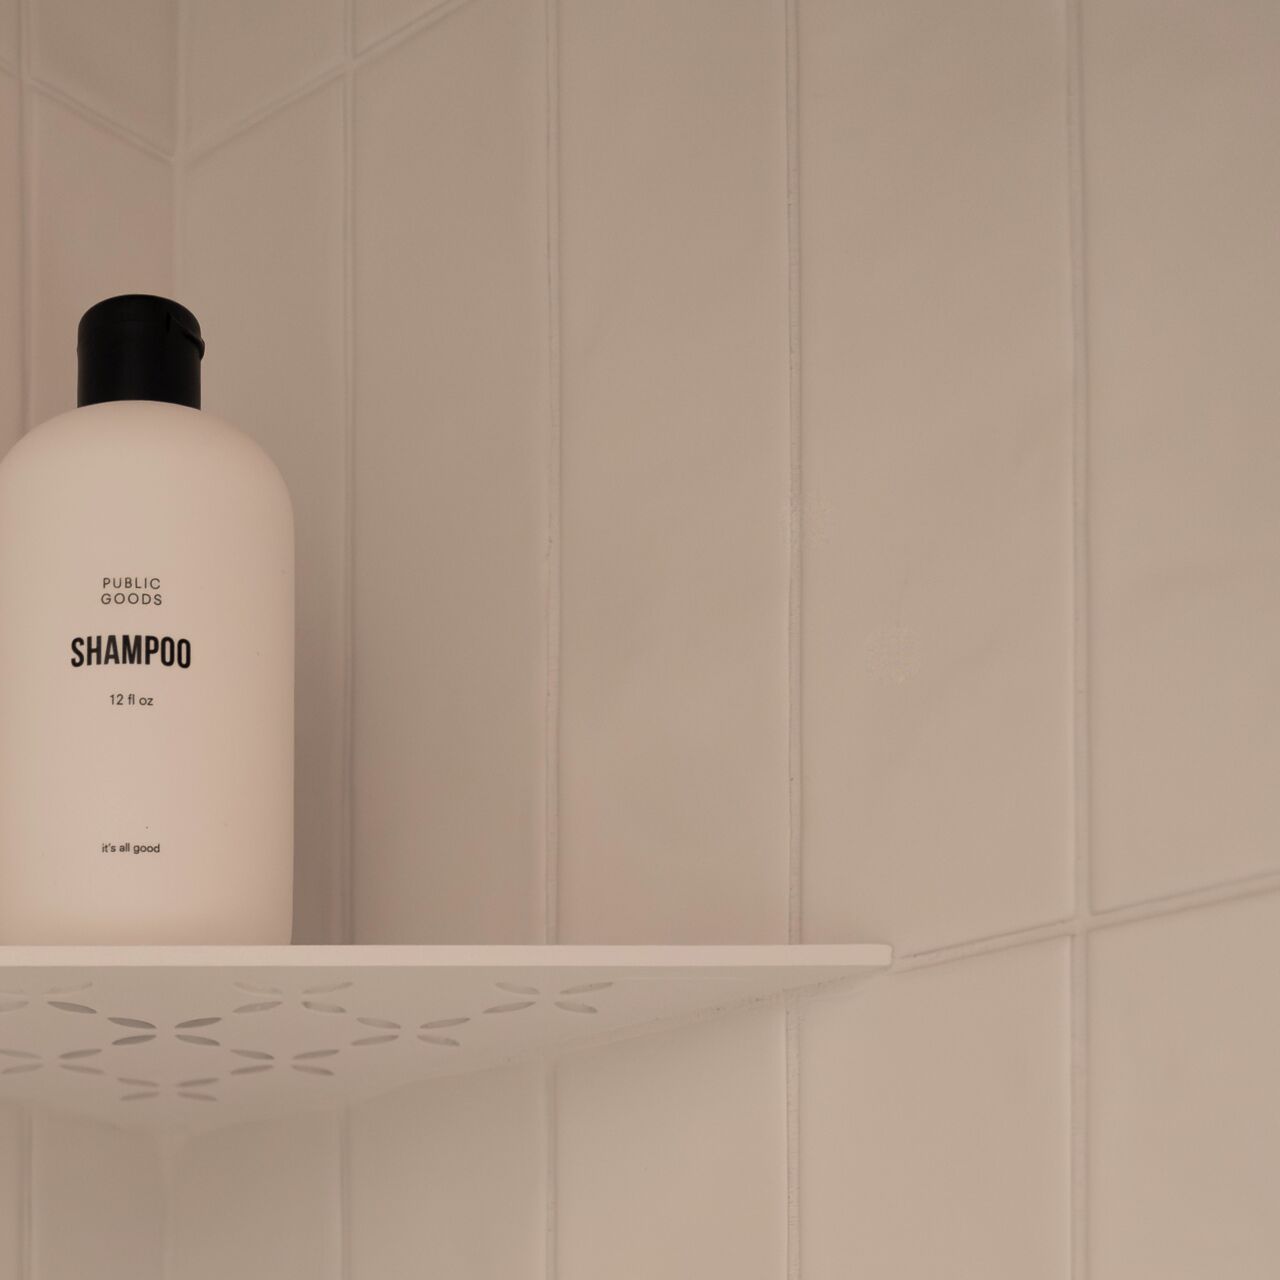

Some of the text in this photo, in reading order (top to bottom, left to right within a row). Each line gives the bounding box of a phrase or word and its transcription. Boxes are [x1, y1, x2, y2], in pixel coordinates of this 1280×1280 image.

[103, 577, 160, 590] PUBLIC
[101, 592, 162, 606] GOODS
[71, 634, 191, 669] SHAMPOO
[109, 693, 154, 707] 12 fl oz
[102, 842, 160, 855] it's all good
